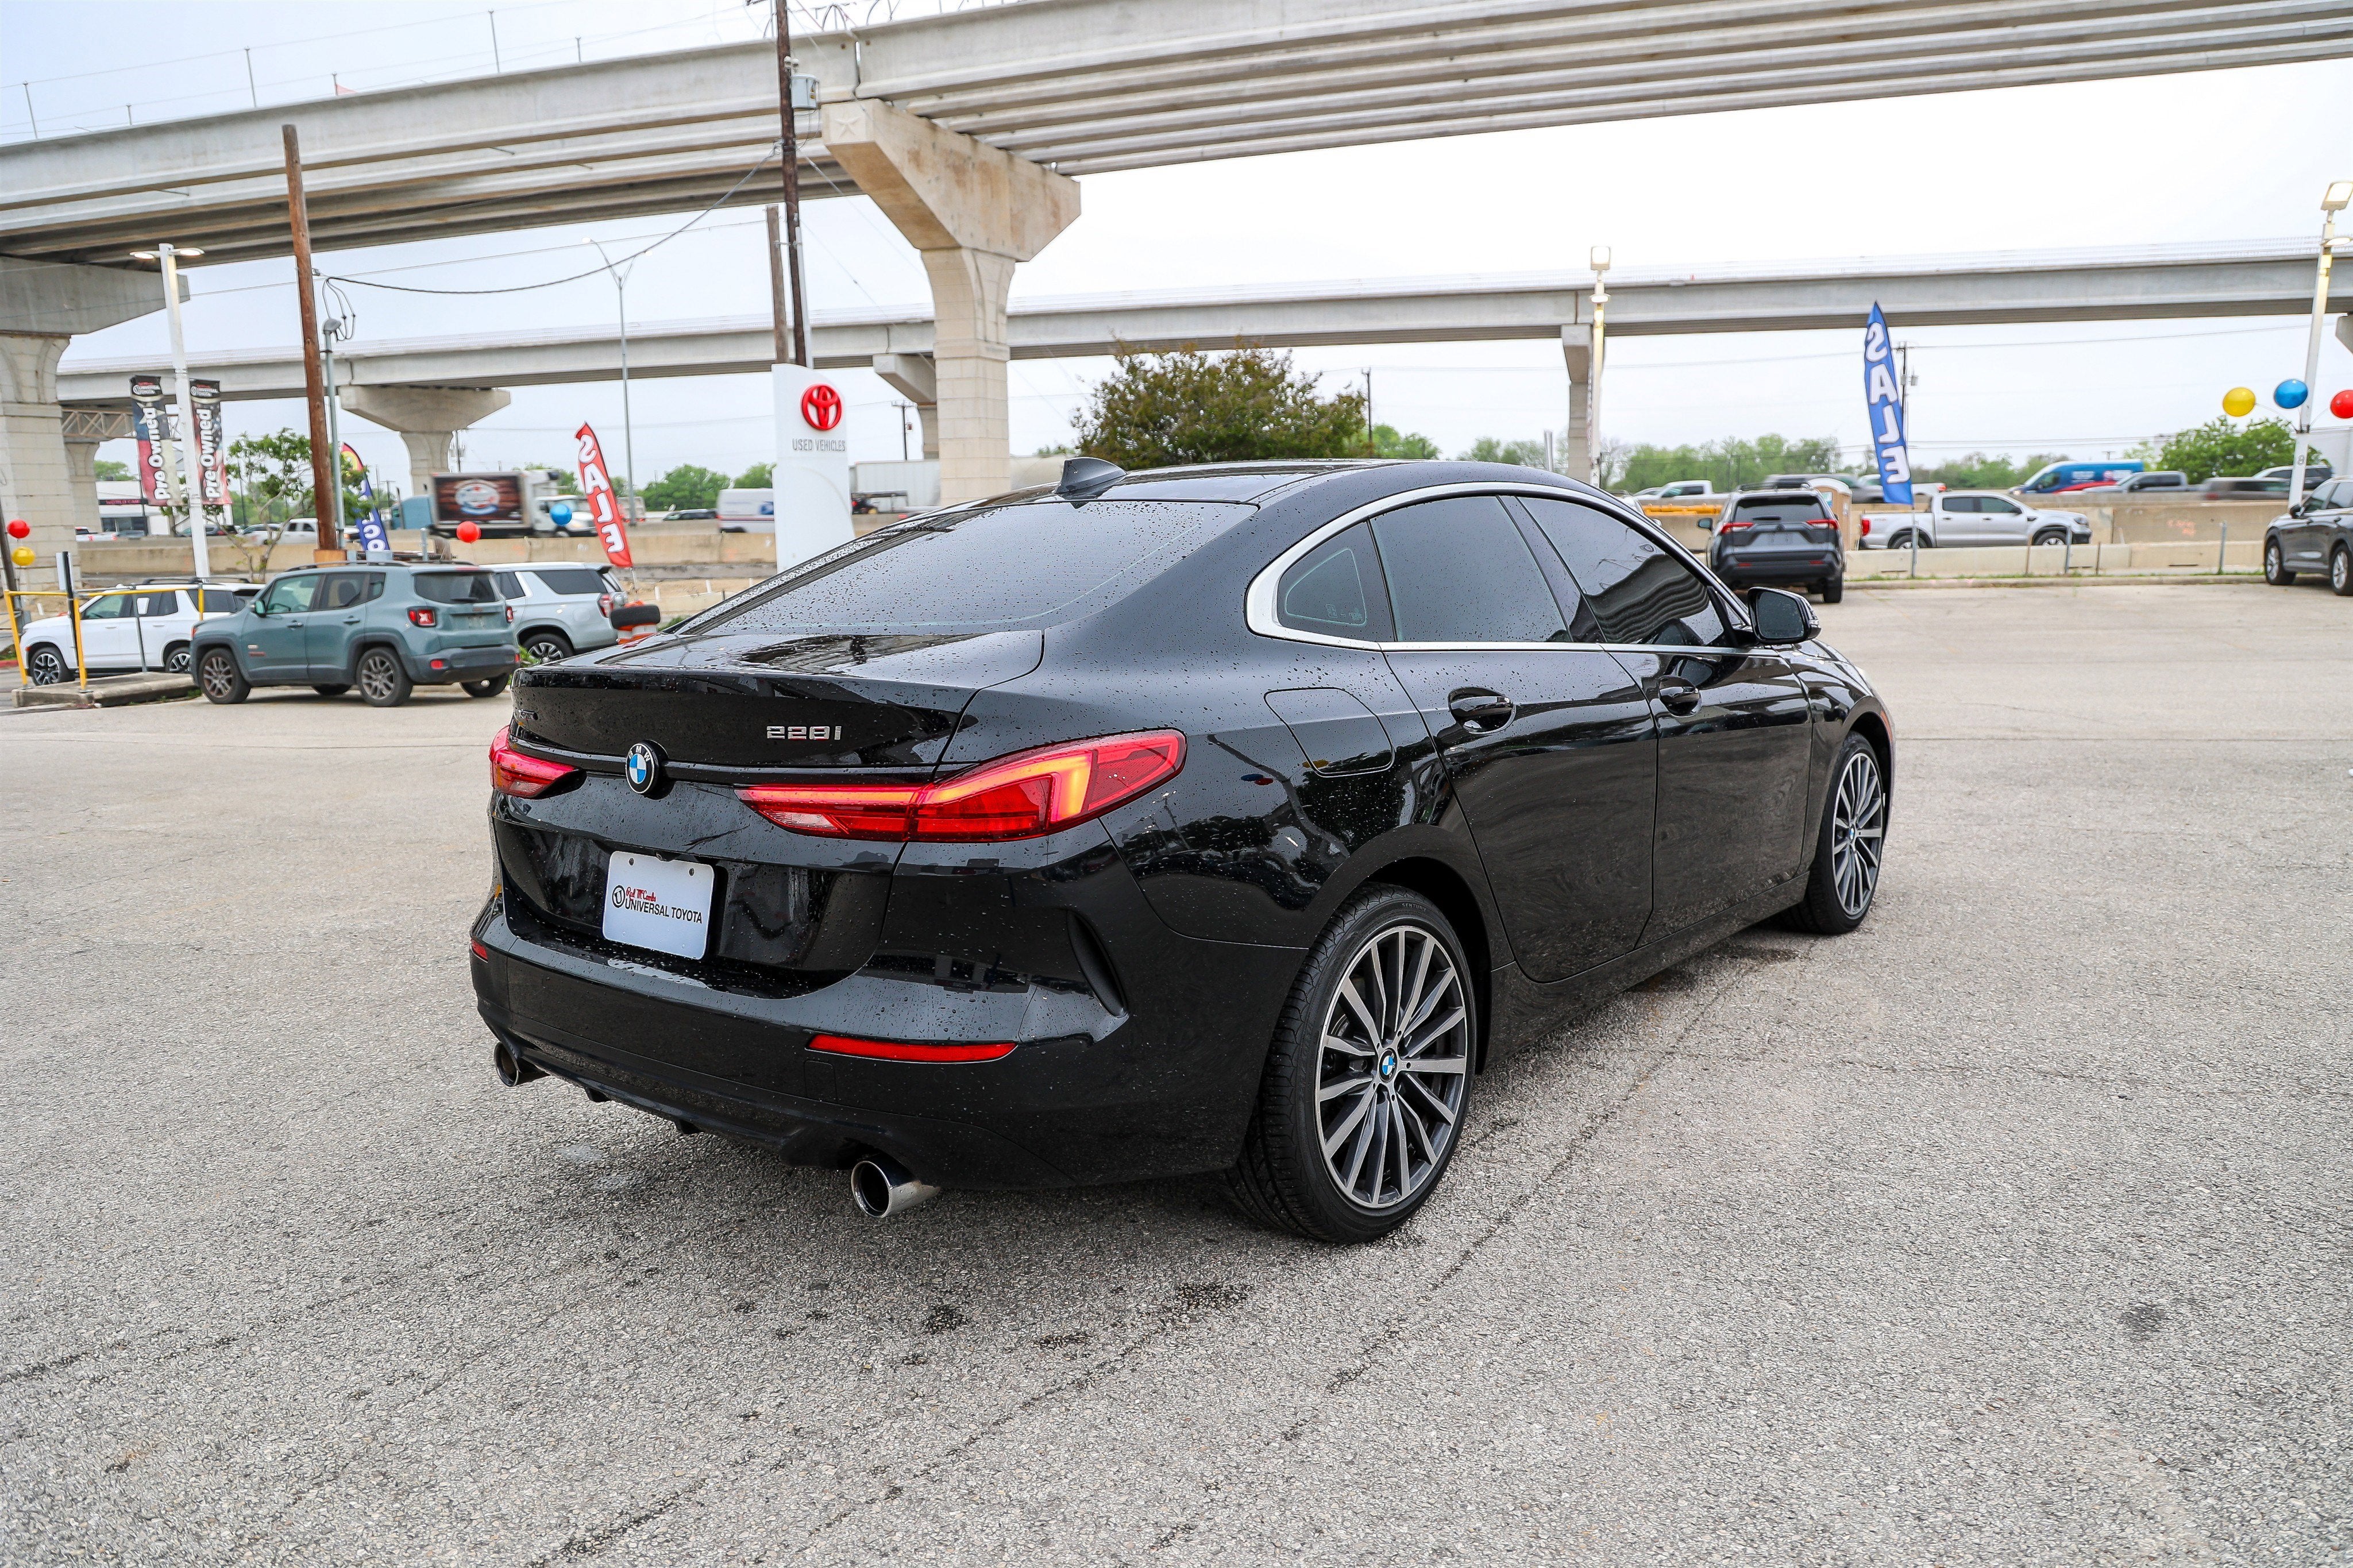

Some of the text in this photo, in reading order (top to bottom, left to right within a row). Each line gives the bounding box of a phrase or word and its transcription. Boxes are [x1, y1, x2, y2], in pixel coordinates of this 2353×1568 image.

[142, 407, 164, 468] Owned
[196, 409, 215, 467] Owned
[792, 438, 845, 451] USED VEHICLES
[154, 470, 171, 500] Pre
[205, 470, 221, 498] Pre
[767, 726, 842, 740] 228i
[628, 746, 650, 762] BMW
[625, 898, 702, 924] UNIVERSAL TOYOTA
